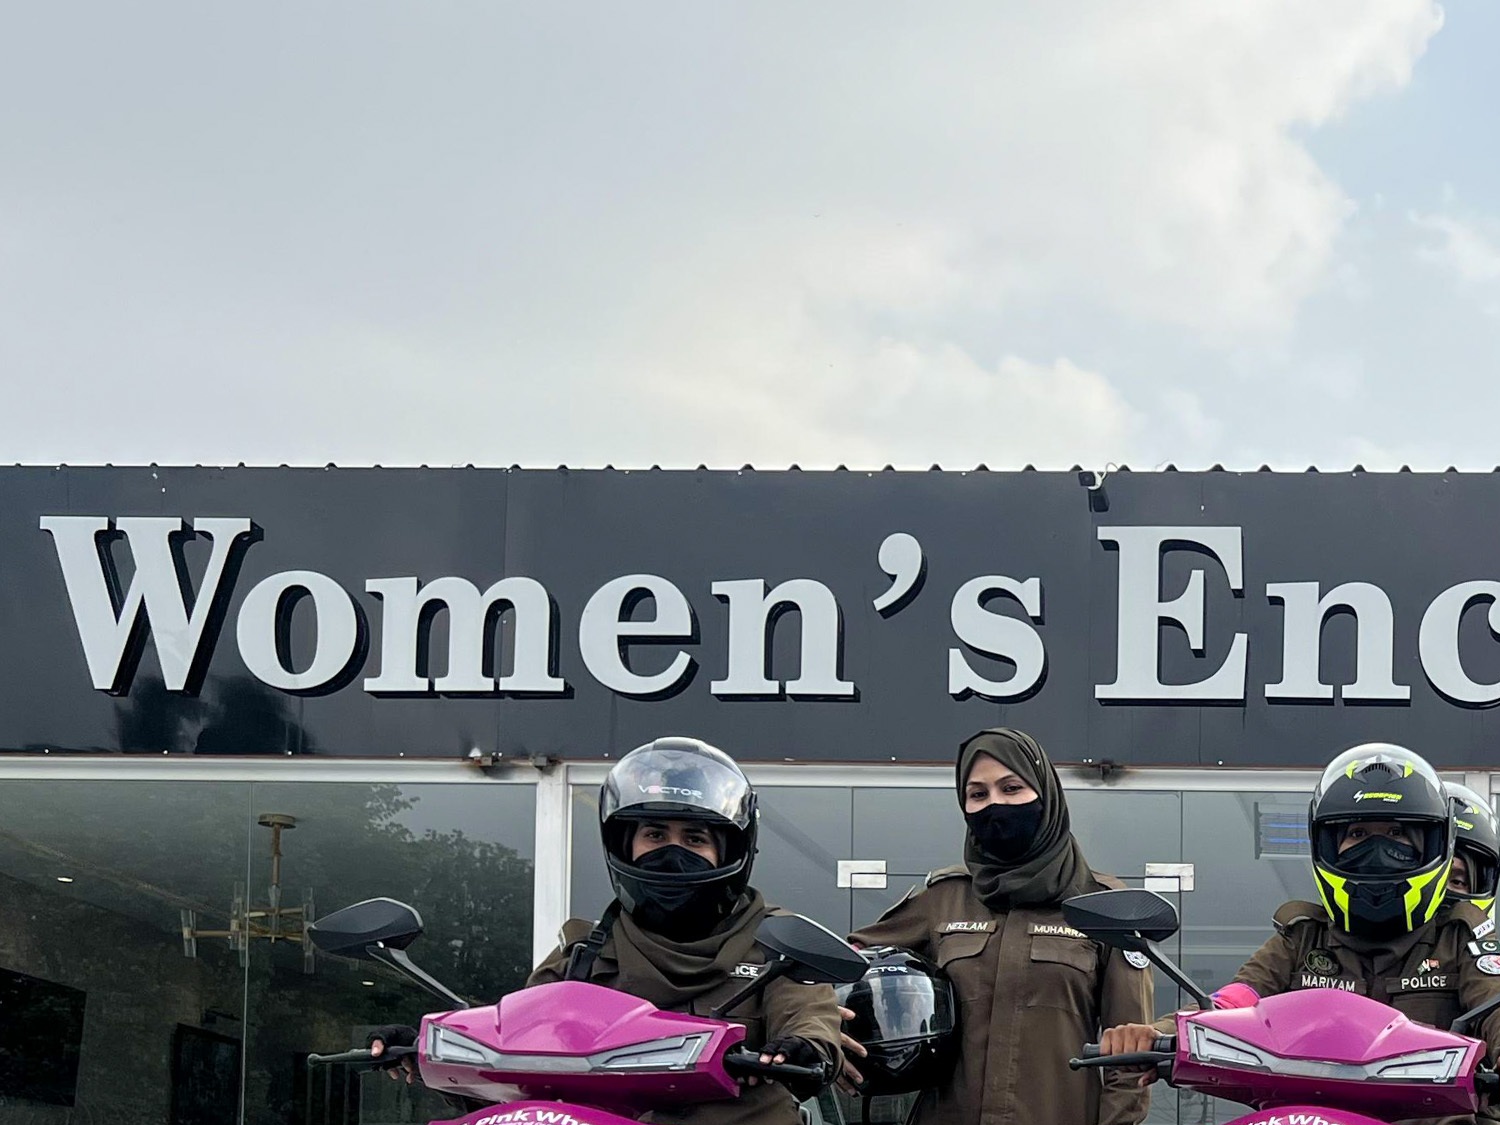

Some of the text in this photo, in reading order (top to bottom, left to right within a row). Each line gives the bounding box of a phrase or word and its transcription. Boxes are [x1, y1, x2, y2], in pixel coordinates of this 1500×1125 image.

[945, 921, 988, 932] NEELAM
[1301, 974, 1356, 993] MARIYAM
[1401, 975, 1447, 990] POLICE
